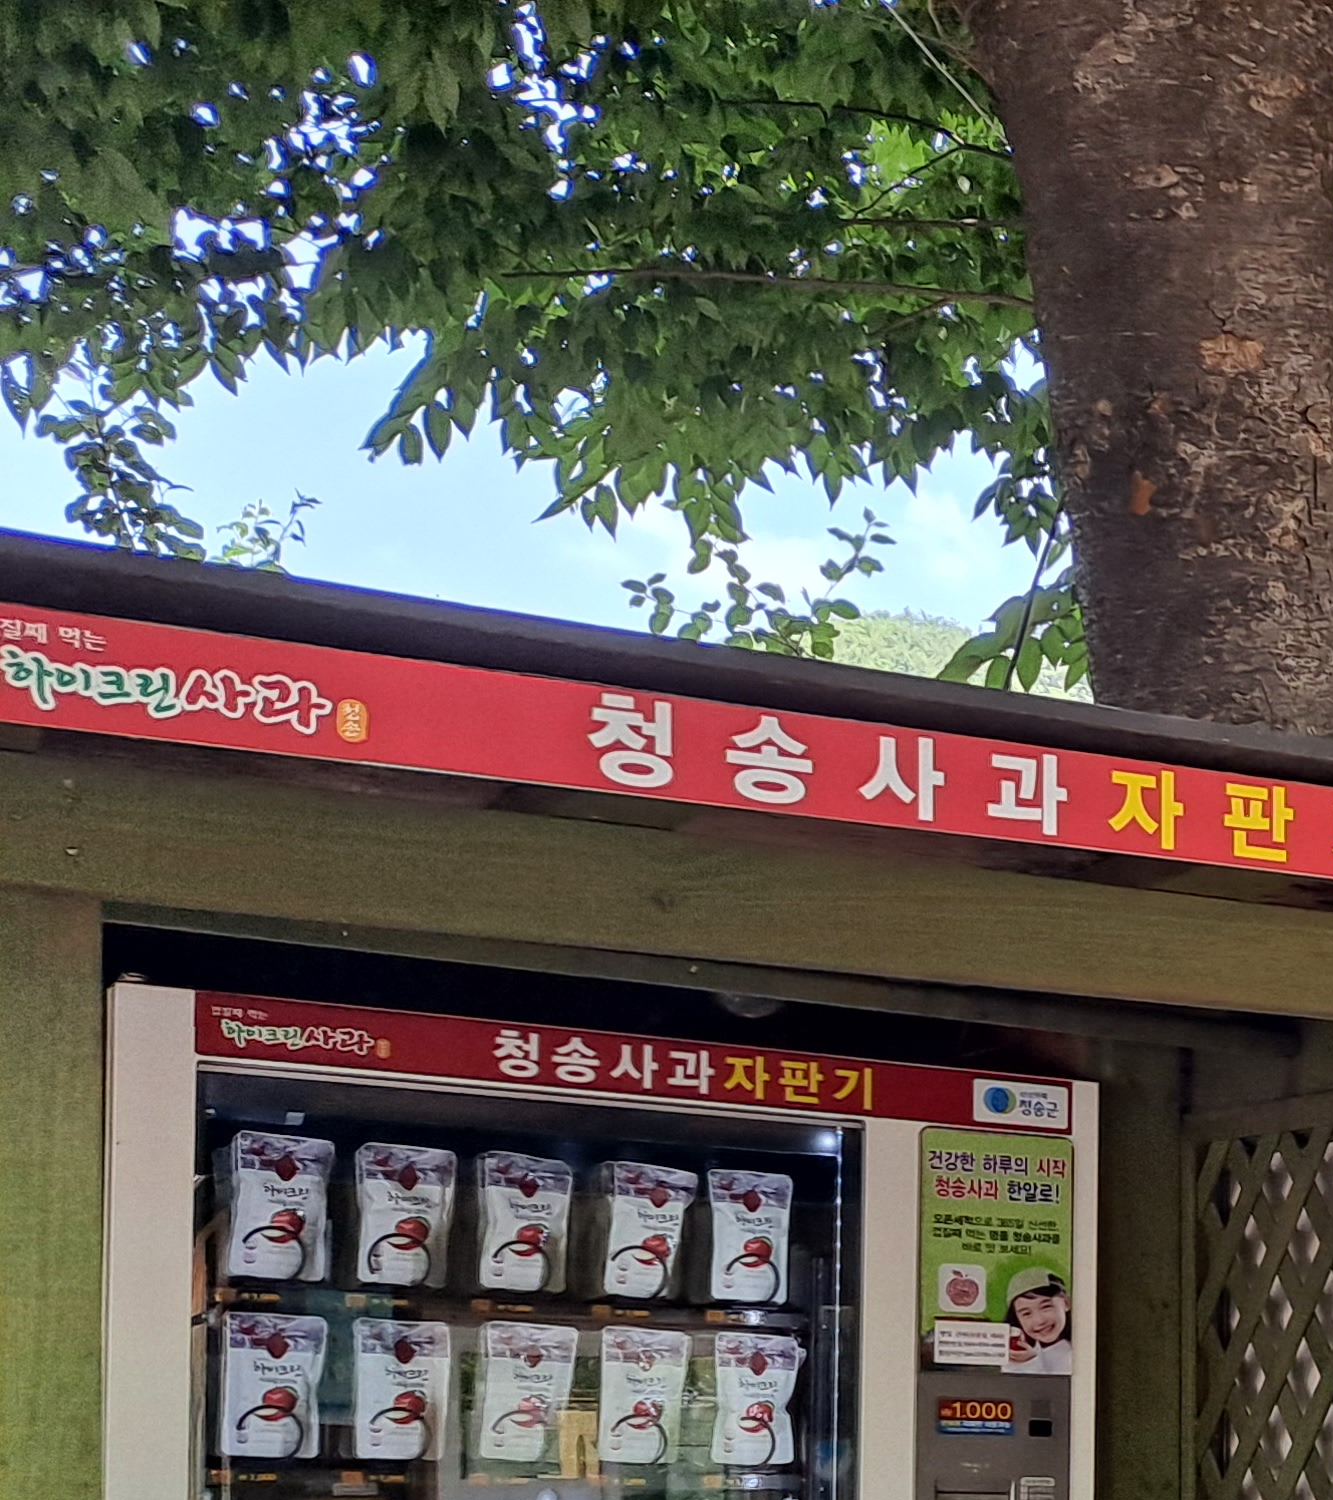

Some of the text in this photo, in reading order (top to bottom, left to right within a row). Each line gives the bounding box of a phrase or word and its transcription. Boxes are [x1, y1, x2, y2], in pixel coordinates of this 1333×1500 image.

[58, 626, 107, 651] 먹는
[928, 1151, 1067, 1178] 건강한 하루의 시작
[935, 1175, 1060, 1204] 청송사과 한알로!
